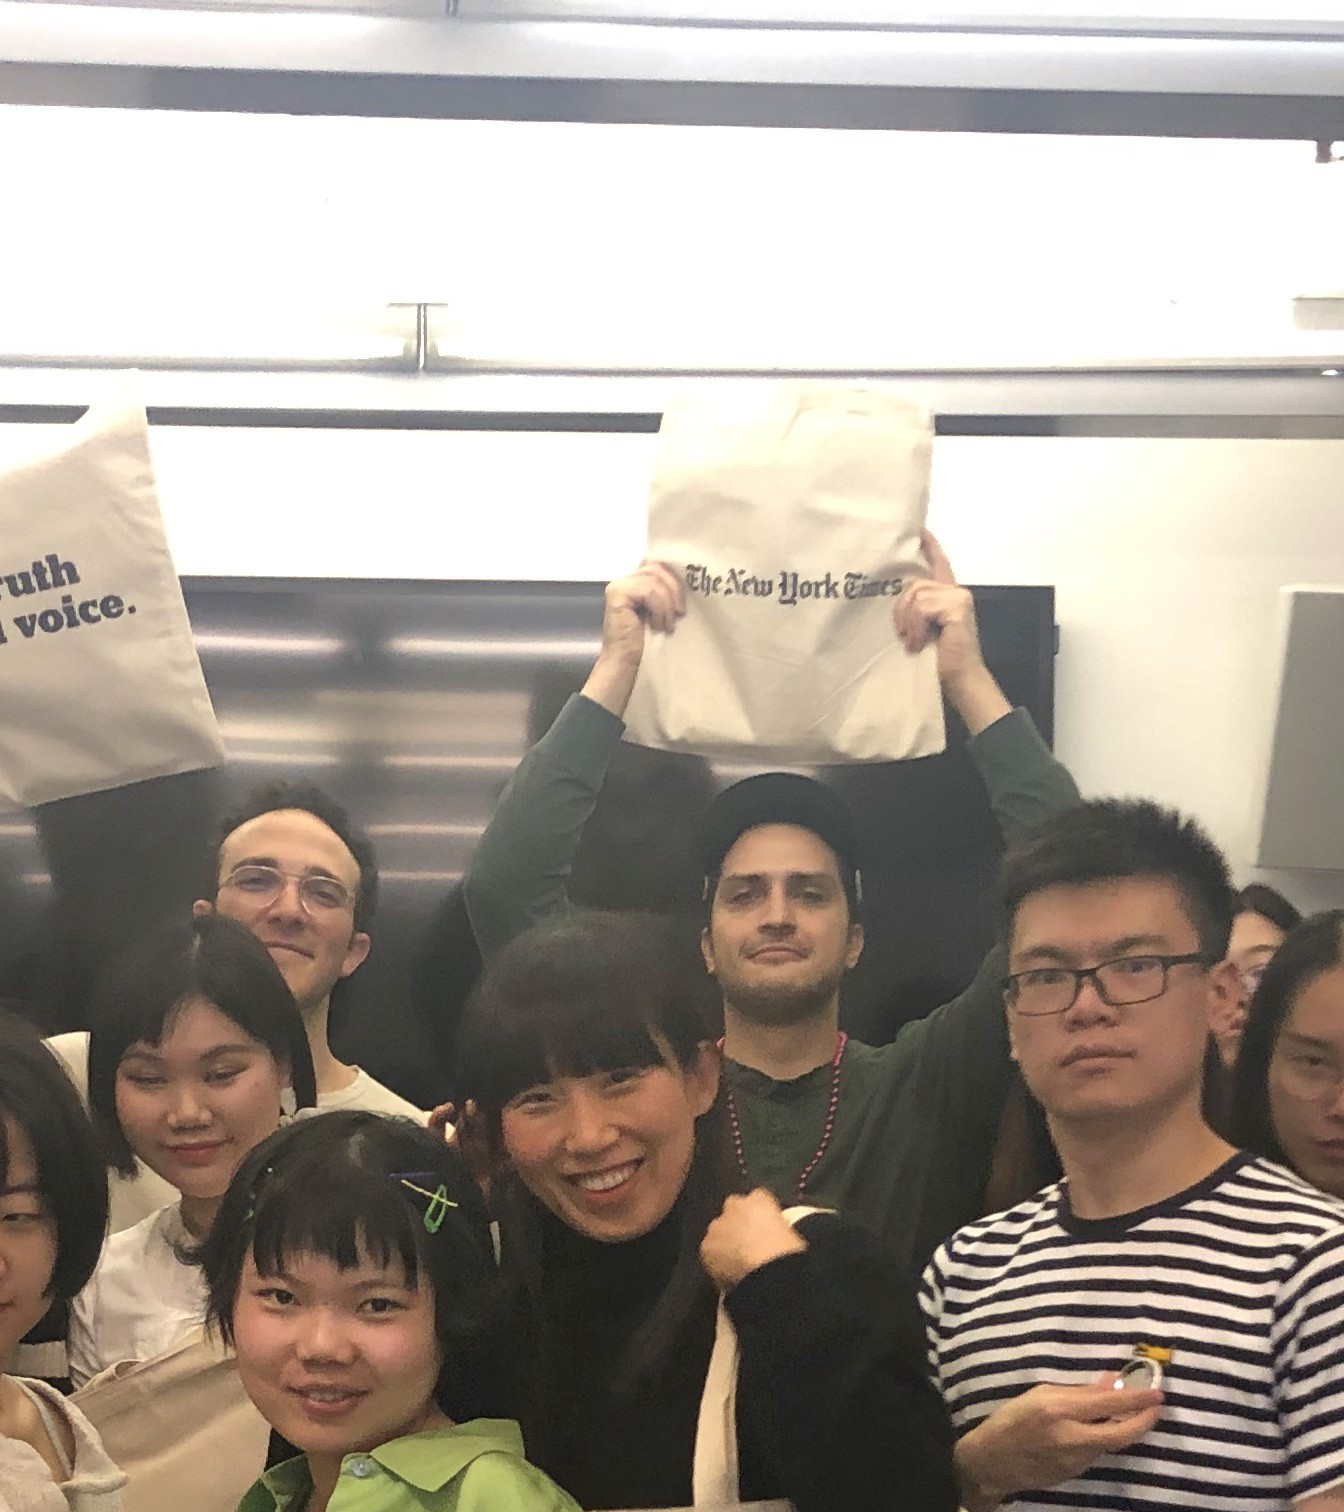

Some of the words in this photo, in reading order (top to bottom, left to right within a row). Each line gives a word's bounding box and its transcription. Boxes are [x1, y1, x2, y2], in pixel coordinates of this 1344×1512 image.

[685, 563, 722, 597] The
[723, 567, 773, 597] New
[779, 570, 840, 607] York
[843, 571, 903, 600] Times
[15, 593, 137, 639] voice.
